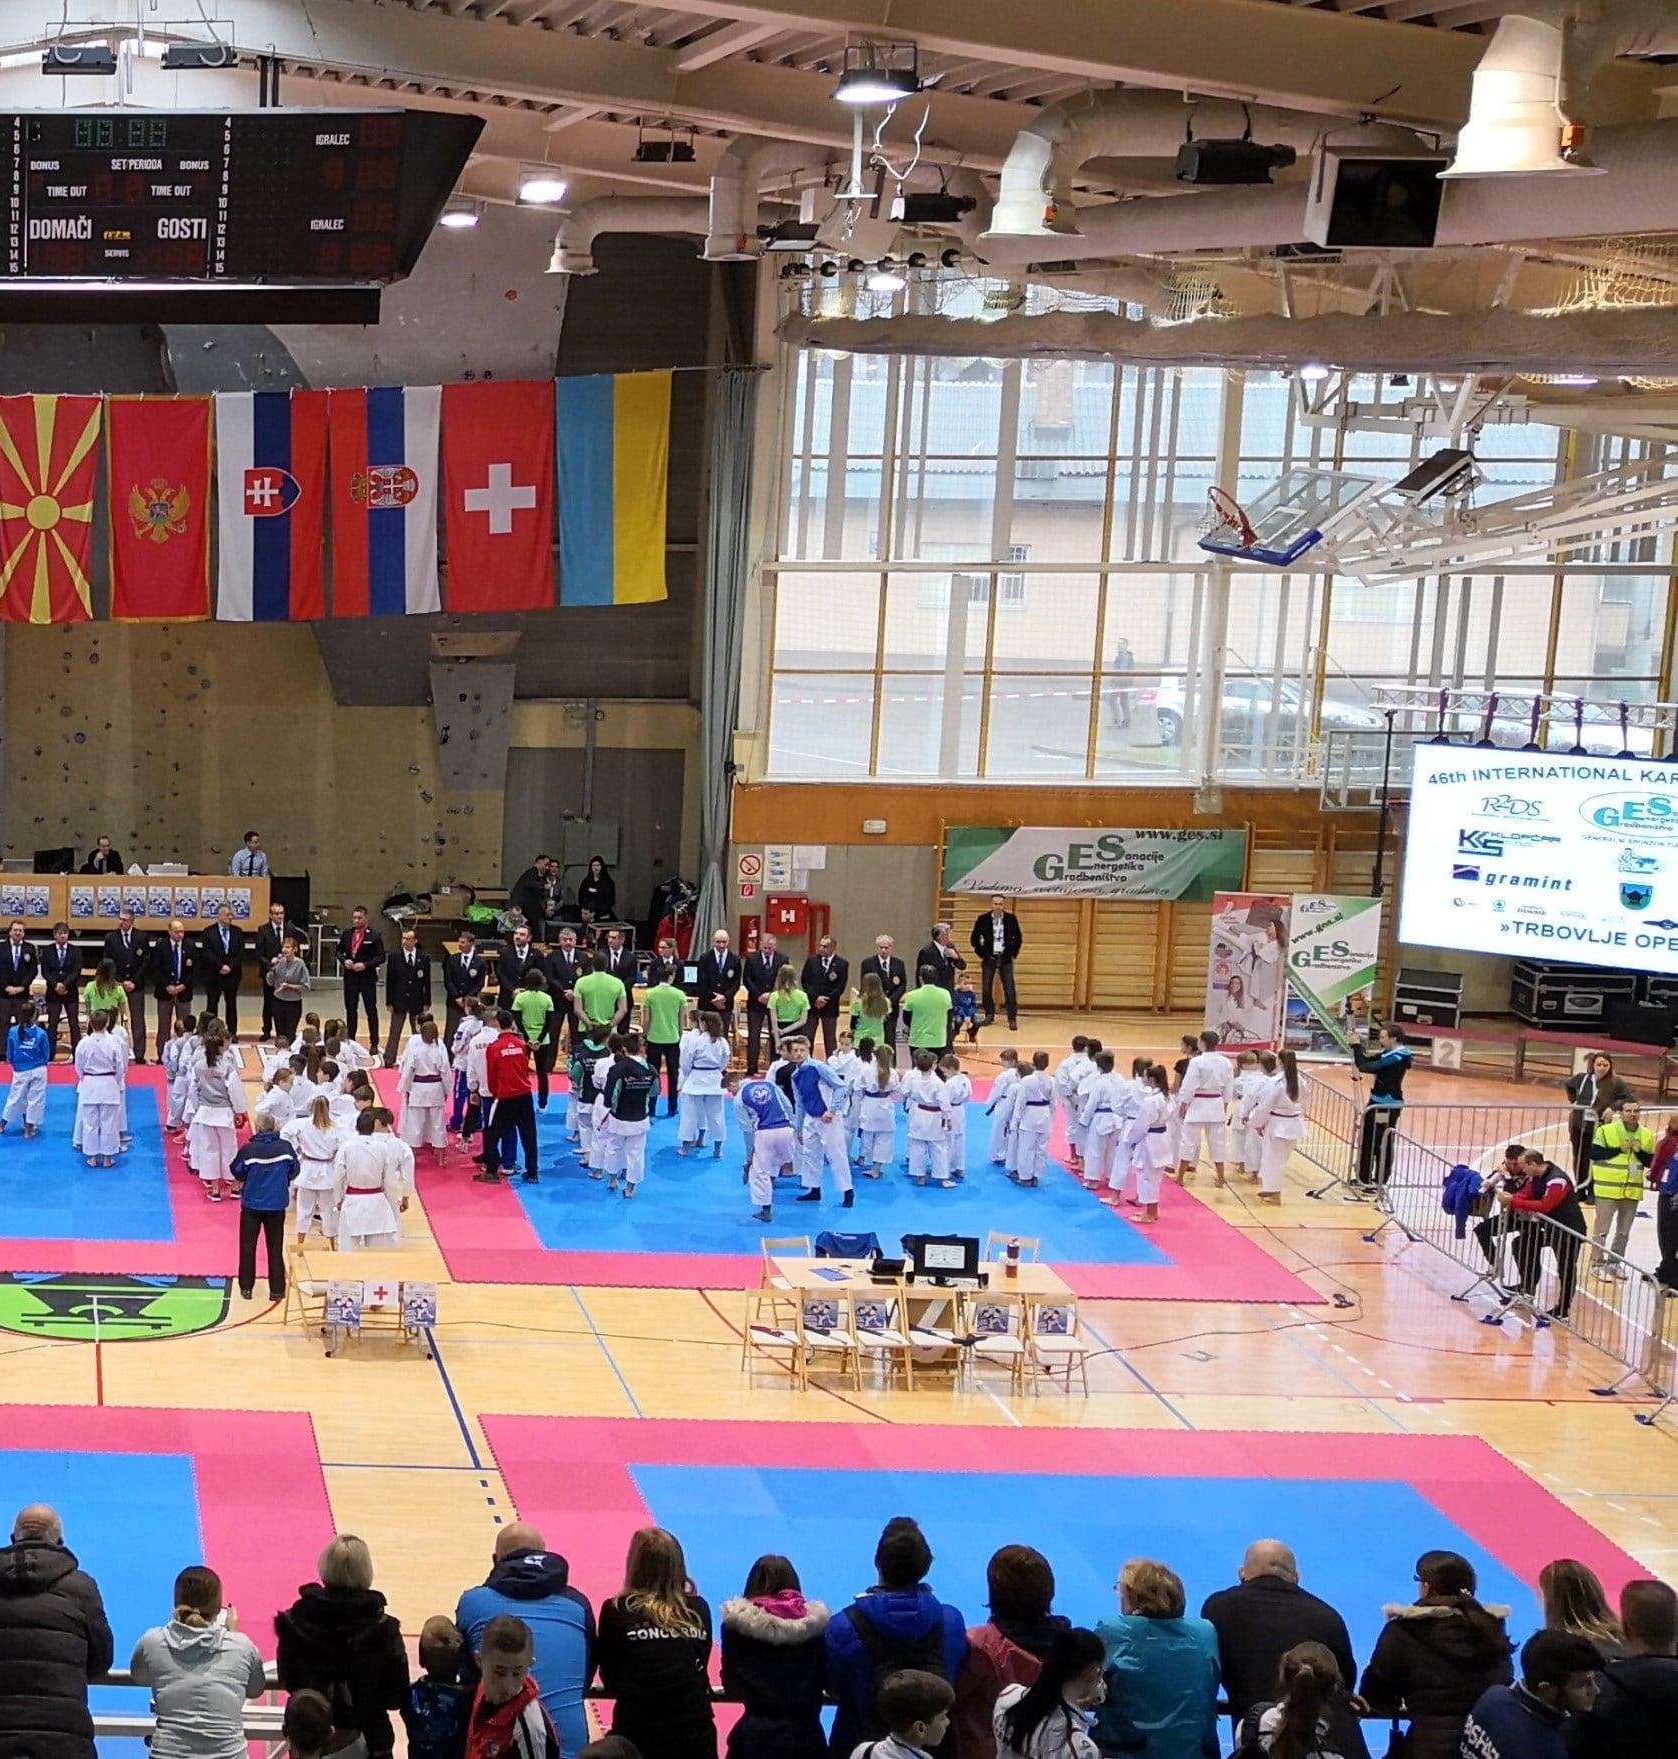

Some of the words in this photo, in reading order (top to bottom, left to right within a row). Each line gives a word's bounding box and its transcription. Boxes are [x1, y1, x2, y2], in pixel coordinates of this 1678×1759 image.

[13, 117, 20, 127] 4
[225, 117, 231, 128] 4
[13, 130, 20, 141] 5
[224, 130, 231, 141] 5
[315, 134, 350, 146] IGRALEC
[13, 143, 20, 155] 6
[224, 144, 230, 155] 6
[13, 157, 19, 168] 7
[30, 160, 60, 170] BONUS
[180, 160, 209, 170] BONUS
[223, 157, 230, 168] 7
[13, 170, 19, 181] 8
[223, 170, 229, 181] 8
[13, 184, 19, 195] 9
[46, 185, 68, 197] TIME
[70, 185, 87, 197] OUT
[151, 185, 172, 197] TIME
[174, 185, 192, 197] OUT
[222, 184, 228, 195] 9
[10, 197, 19, 208] 10
[218, 197, 227, 208] 10
[11, 211, 19, 221] 11
[219, 210, 227, 221] 11
[10, 224, 18, 234] 12
[29, 215, 92, 240] DOMAČI
[157, 218, 207, 239] GOSTI
[217, 224, 226, 234] 12
[310, 218, 345, 230] IGRALEC
[10, 237, 18, 247] 13
[216, 237, 225, 248] 13
[10, 250, 18, 260] 14
[216, 250, 225, 260] 14
[9, 262, 18, 273] 15
[215, 263, 224, 273] 15
[1428, 771, 1467, 784] 46th
[1472, 766, 1633, 782] INTERNATIONAL
[1593, 797, 1672, 827] GES
[1135, 828, 1224, 842] www.ges.si
[1033, 834, 1126, 881] GES
[1485, 873, 1573, 891] gramint
[781, 910, 795, 922] H
[1291, 940, 1350, 968] GES
[1439, 1042, 1454, 1066] 2
